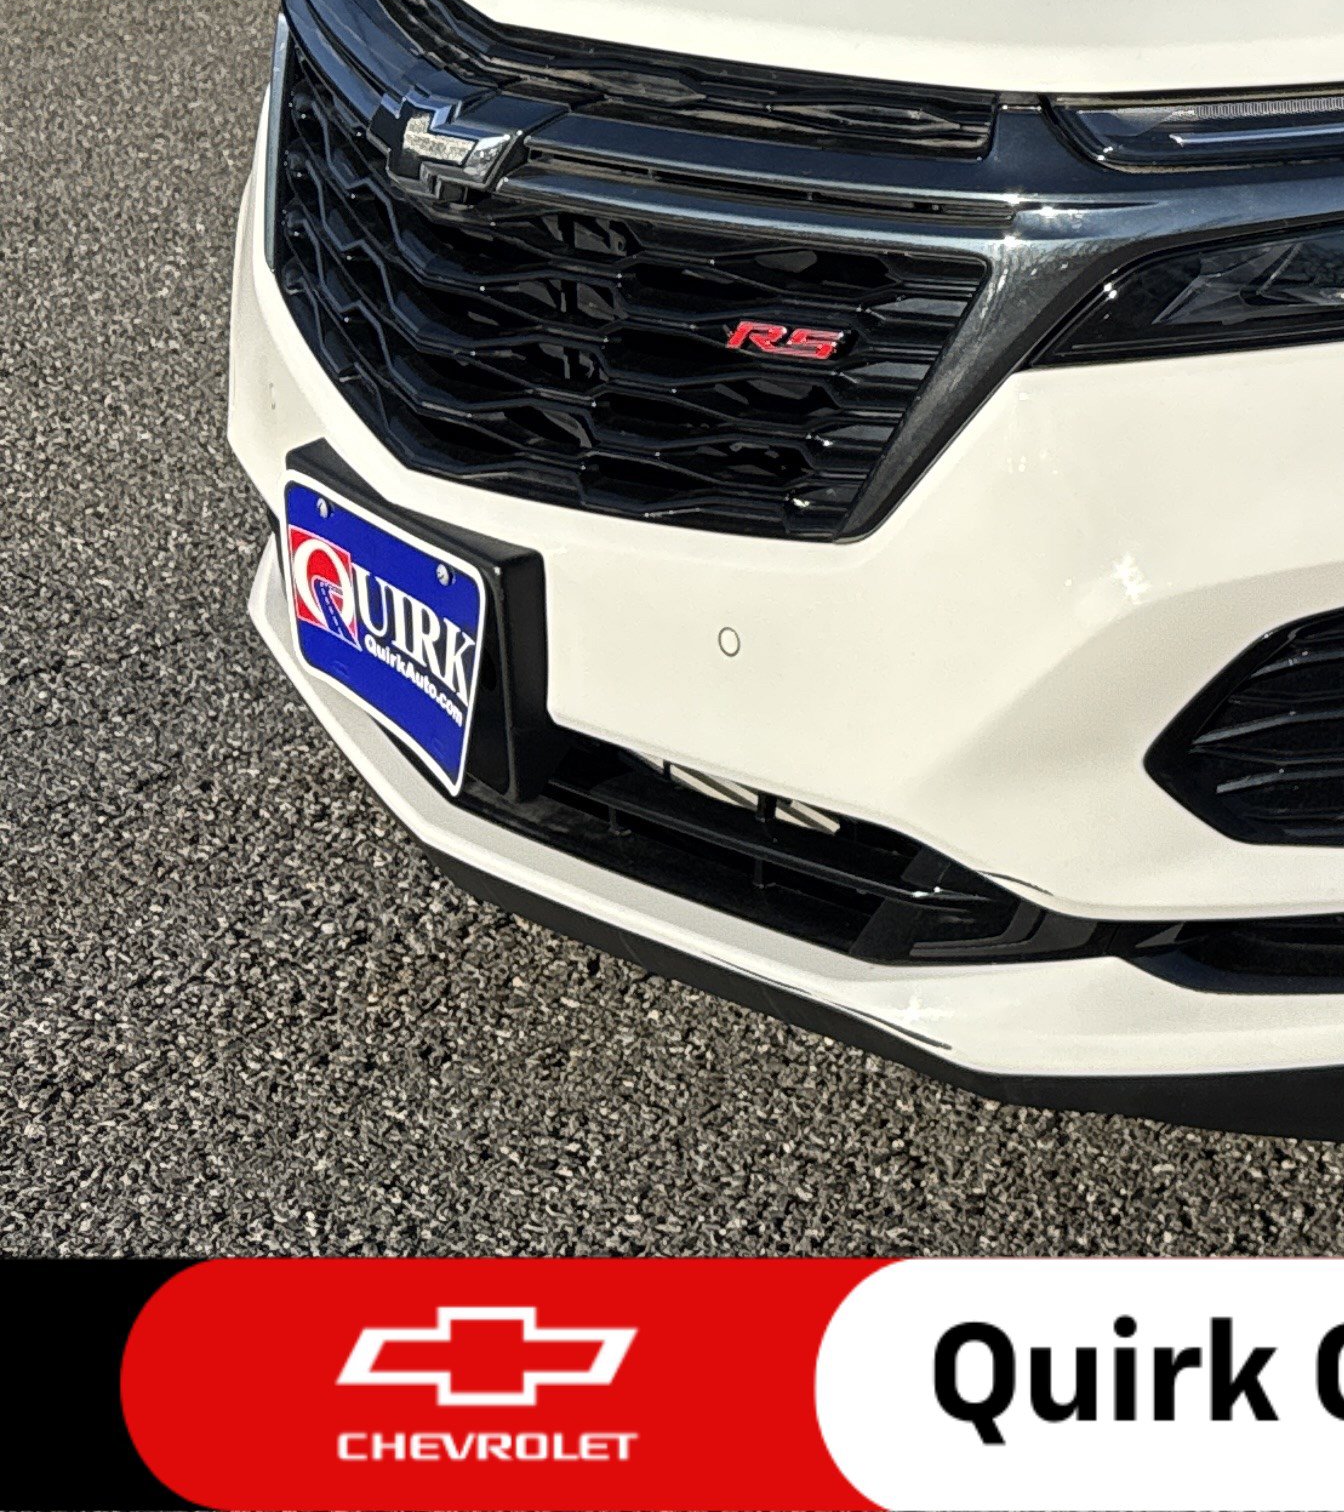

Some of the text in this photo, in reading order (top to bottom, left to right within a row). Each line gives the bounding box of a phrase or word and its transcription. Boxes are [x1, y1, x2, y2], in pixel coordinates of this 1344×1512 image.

[725, 319, 848, 360] RS
[292, 538, 475, 706] QUIRK
[365, 633, 464, 728] QuirkAuto.com
